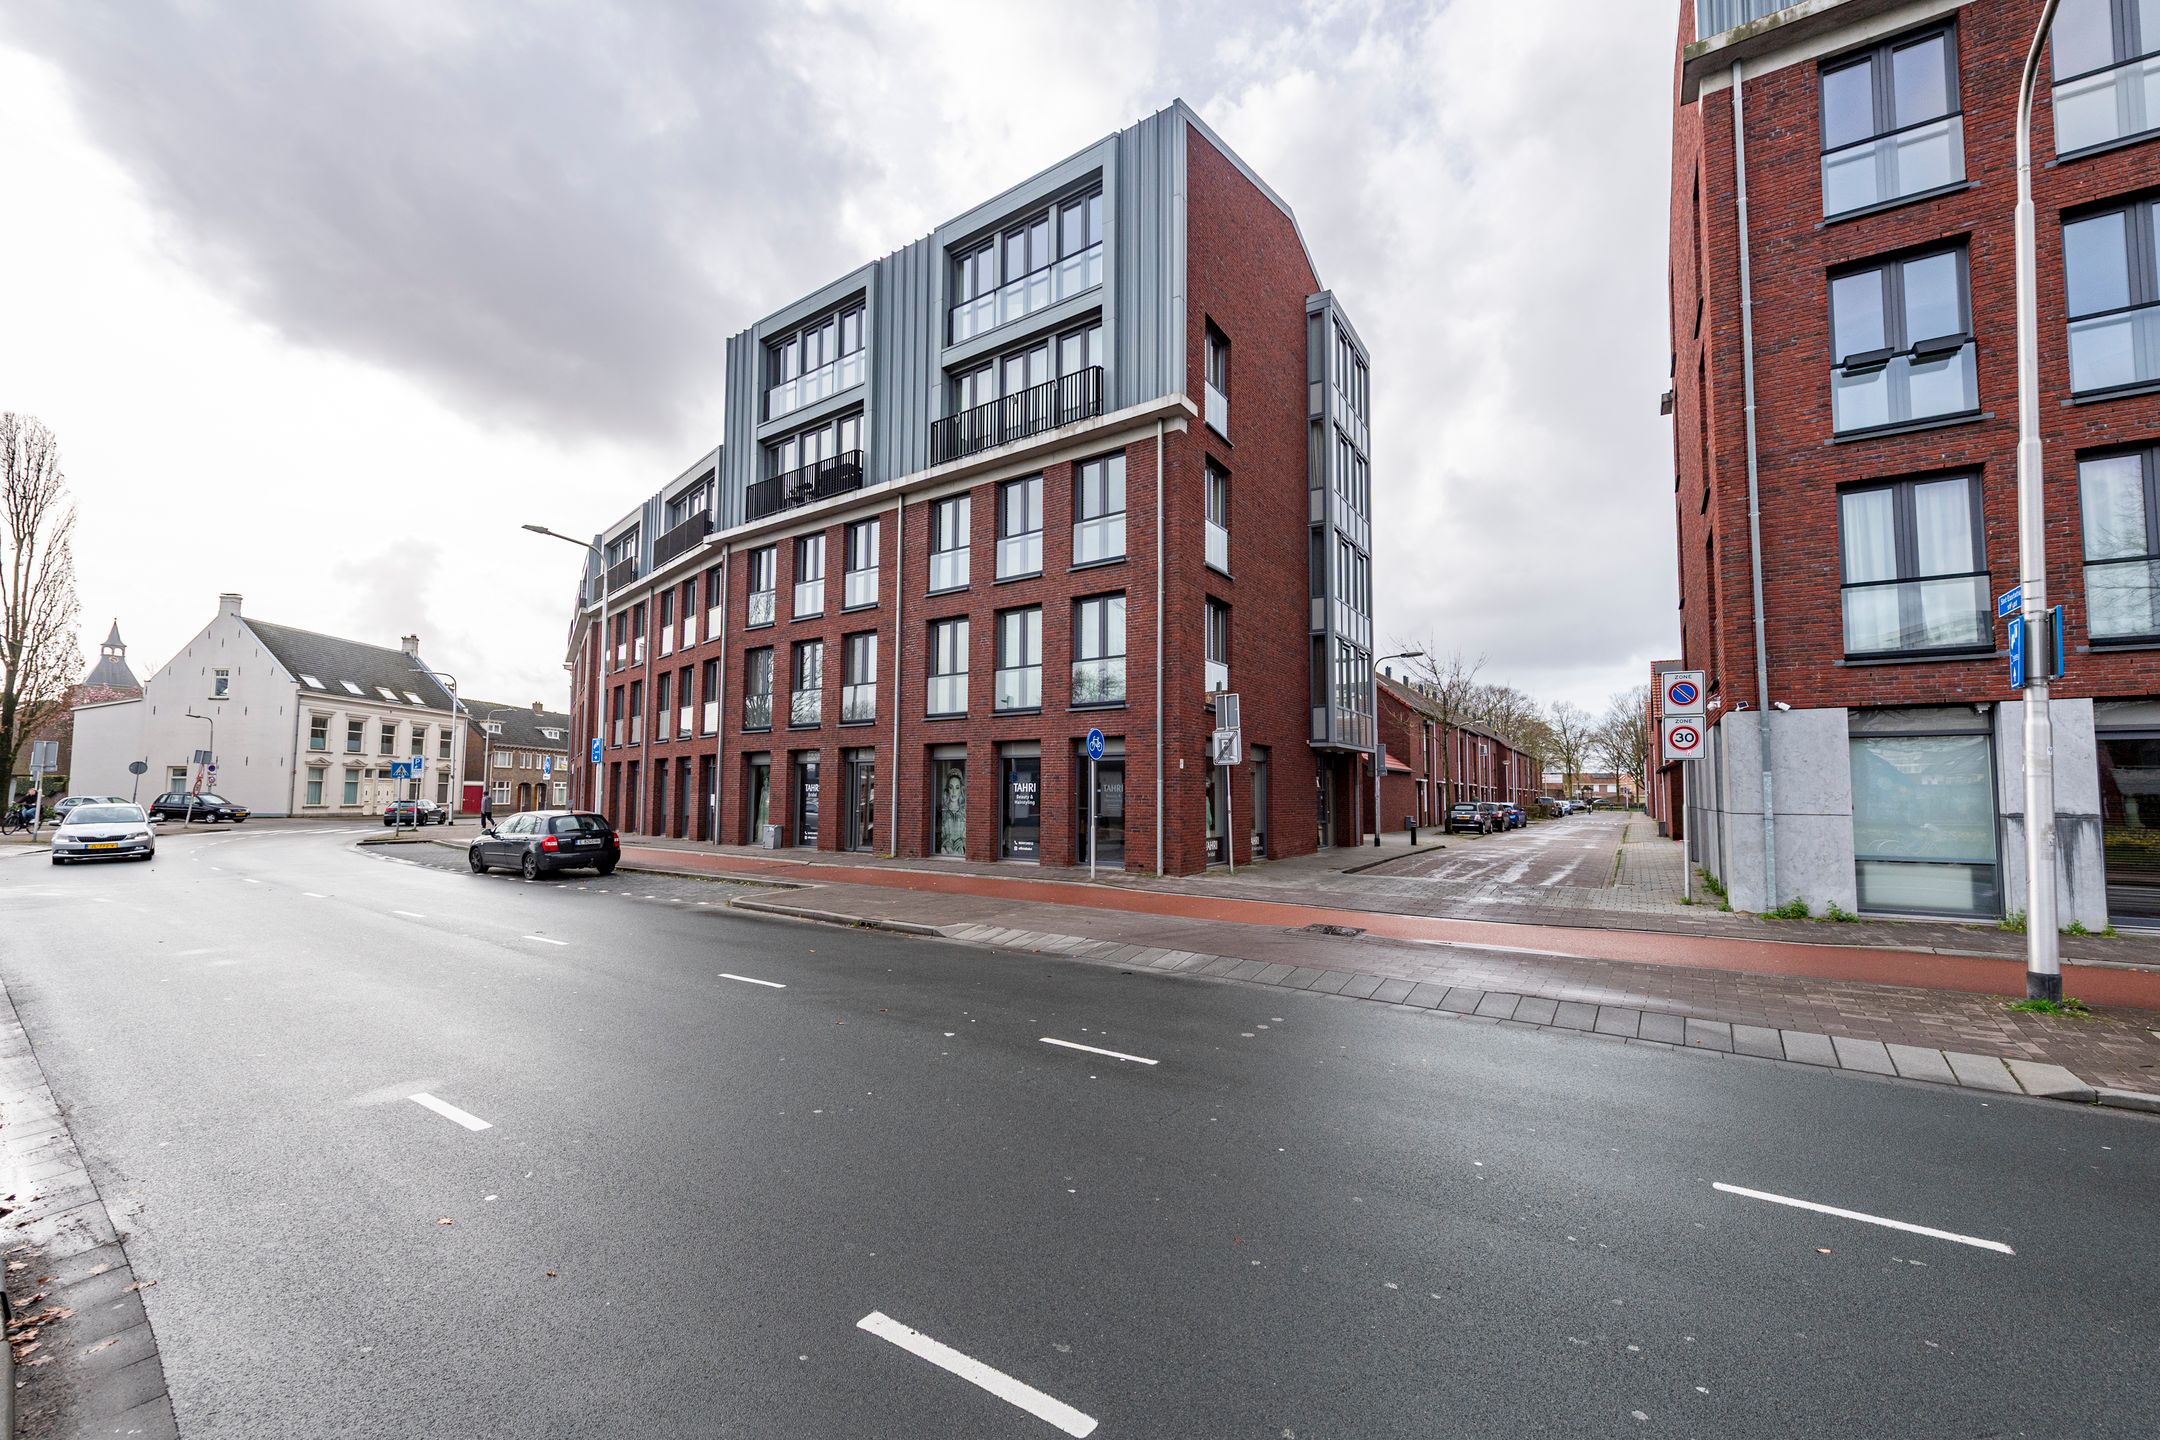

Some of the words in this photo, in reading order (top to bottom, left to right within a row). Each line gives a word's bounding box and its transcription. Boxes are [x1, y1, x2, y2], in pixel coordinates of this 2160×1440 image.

[1675, 732, 1695, 743] 30
[804, 784, 820, 792] TAHR
[1013, 783, 1036, 792] TAHRI
[1103, 784, 1123, 792] TAHRI
